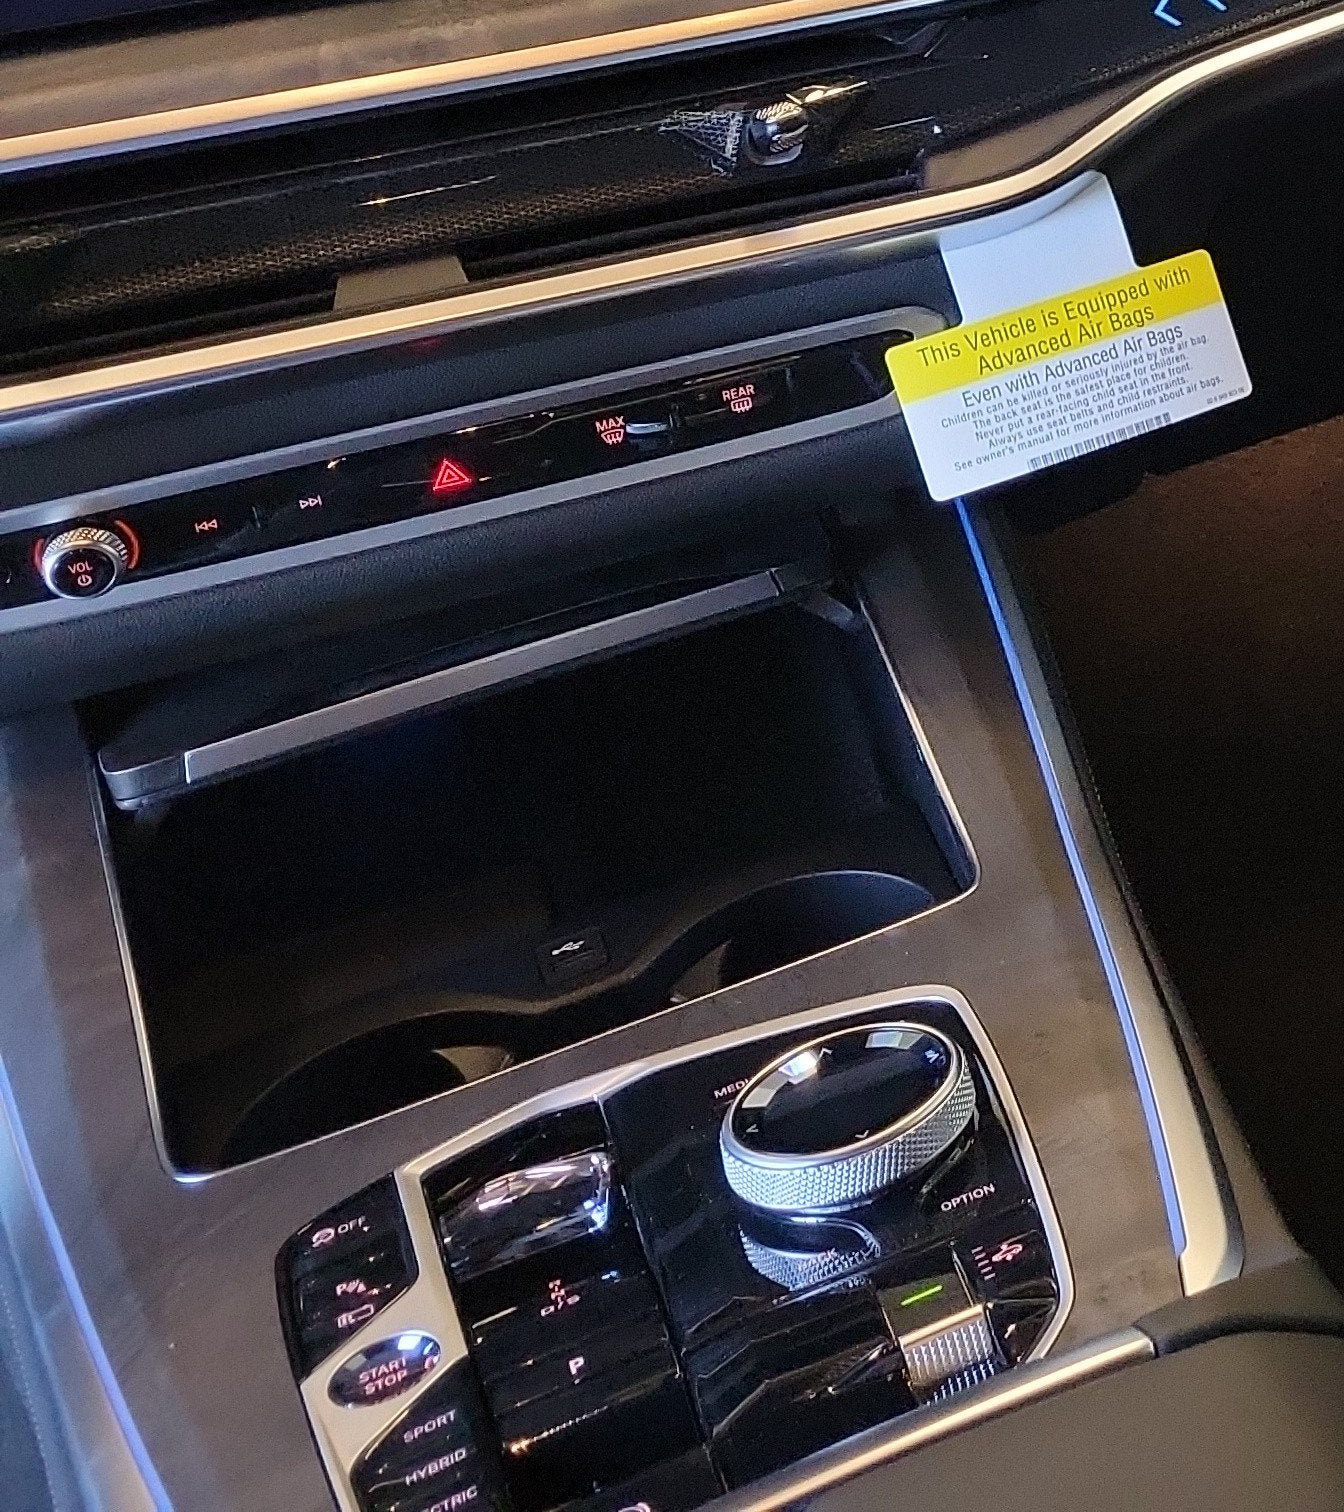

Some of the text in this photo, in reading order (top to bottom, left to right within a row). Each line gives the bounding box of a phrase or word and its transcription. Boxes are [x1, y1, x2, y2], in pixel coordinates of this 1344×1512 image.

[916, 266, 1191, 367] This Vehicle is Equipped with
[978, 305, 1155, 376] Advanced Air Bags
[962, 325, 1183, 408] Even with Advanced Air Bags
[721, 384, 755, 402] REAR
[941, 409, 988, 429] Children
[986, 402, 1004, 415] can
[1007, 395, 1020, 408] be
[1022, 386, 1048, 402] killed
[1051, 383, 1063, 396] or
[1064, 365, 1109, 389] seriously
[1111, 353, 1144, 371] injured
[1146, 350, 1158, 364] by
[1159, 344, 1175, 355] the
[1177, 341, 1189, 351] air
[974, 419, 992, 430] The
[994, 409, 1018, 422] back
[1020, 401, 1043, 414] seat
[1044, 396, 1054, 406] is
[1056, 391, 1071, 403] the
[1075, 381, 1104, 396] safest
[1106, 371, 1135, 386] place
[1135, 365, 1148, 376] for
[975, 425, 1004, 441] Never
[1007, 418, 1025, 433] put
[1036, 396, 1089, 422] rear-facing
[1092, 387, 1116, 403] child
[1118, 381, 1139, 394] seat
[1140, 376, 1149, 386] in
[1151, 370, 1166, 381] the
[989, 431, 1024, 449] Always
[1026, 425, 1044, 436] use
[1047, 417, 1067, 430] seat
[1069, 406, 1094, 422] belts
[1097, 399, 1115, 413] and
[1117, 391, 1141, 406] child
[594, 415, 626, 433] MAX
[954, 459, 973, 472] See
[976, 446, 1015, 465] owner's
[1017, 432, 1054, 451] manual
[1056, 427, 1071, 438] for
[1073, 417, 1100, 432] more
[1101, 399, 1157, 420] information
[1159, 389, 1185, 403] about
[1187, 383, 1198, 393] air
[67, 560, 93, 574] VOL
[940, 1182, 996, 1212] OPTION
[337, 1215, 367, 1234] OFF
[358, 1355, 407, 1385] START
[568, 1356, 585, 1375] P
[364, 1370, 408, 1396] STOP
[403, 1410, 457, 1444] SPORT
[405, 1447, 468, 1487] HYBRID
[422, 1484, 478, 1512] CTRIC
